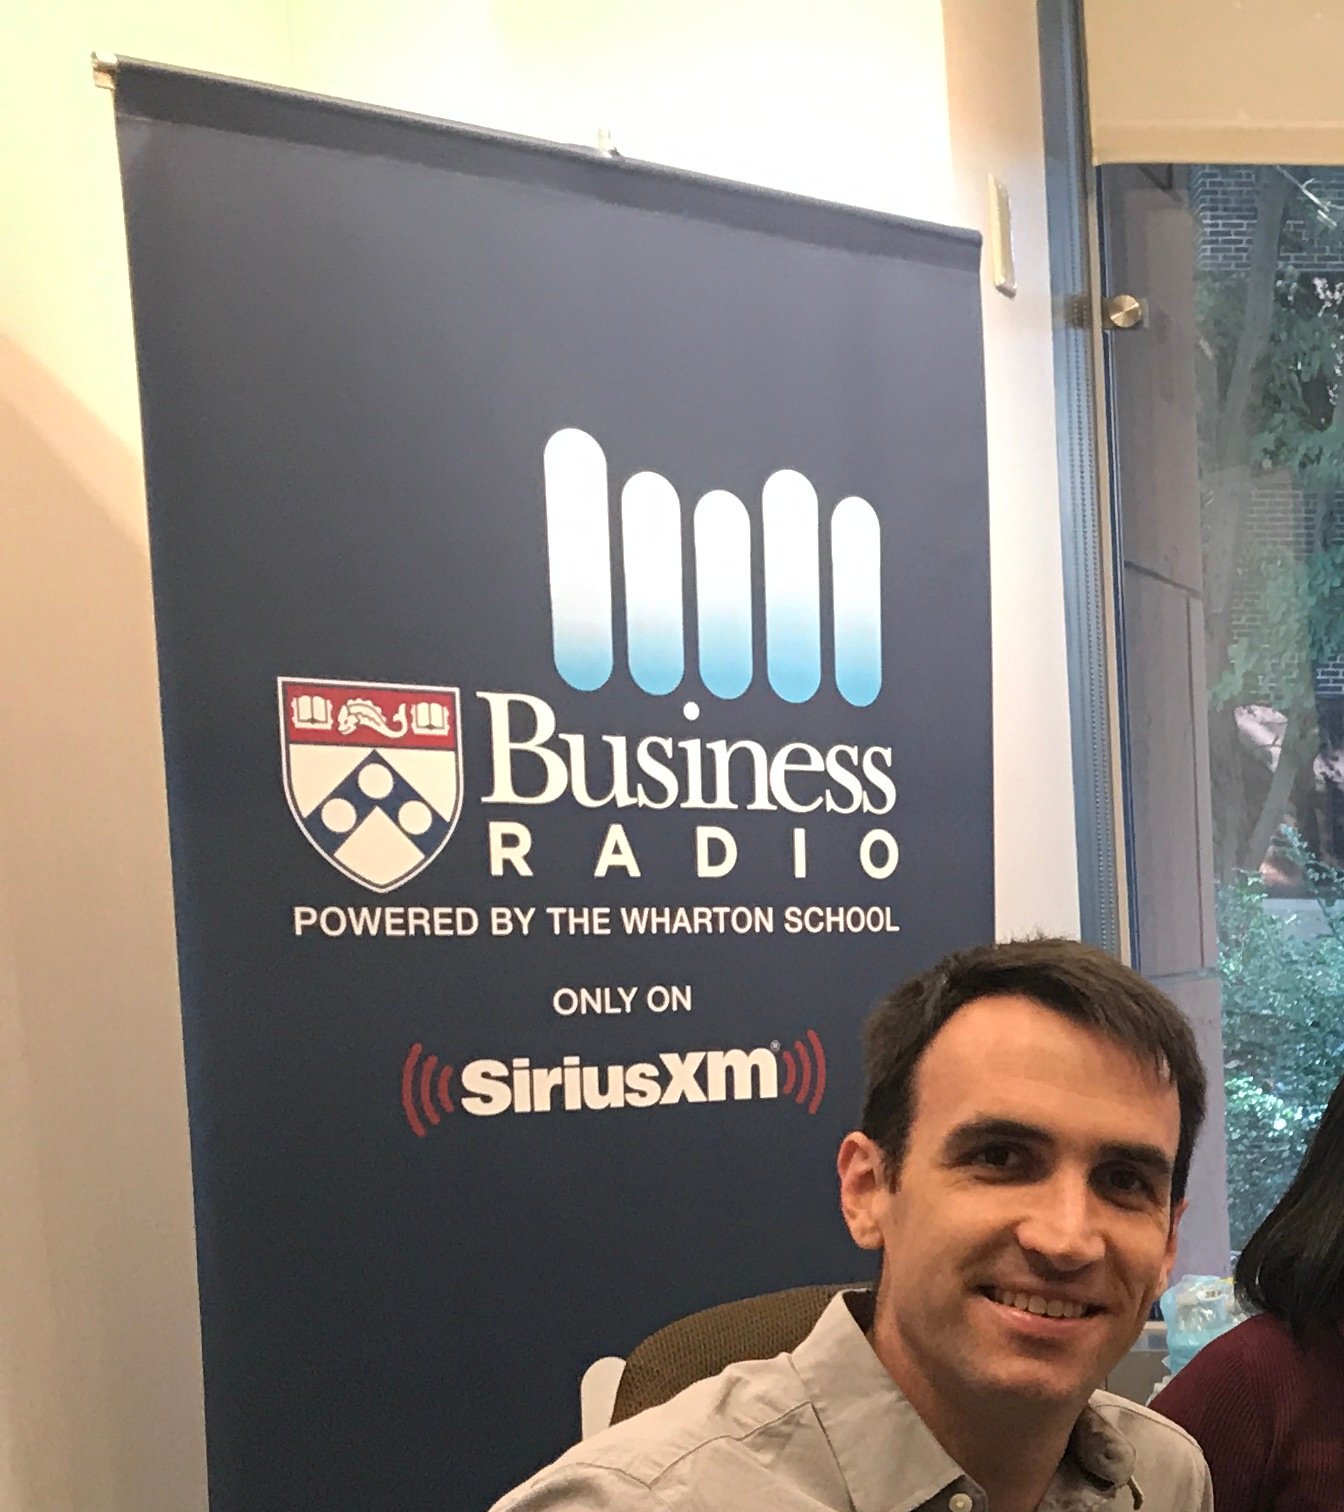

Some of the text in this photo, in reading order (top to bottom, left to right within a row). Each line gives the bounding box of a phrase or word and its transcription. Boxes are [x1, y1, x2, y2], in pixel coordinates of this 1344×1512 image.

[476, 690, 897, 815] Business
[488, 820, 900, 880] RADIO
[293, 905, 900, 938] POWERED BY THE WHARTON SCHOOL
[552, 985, 693, 1016] ONLY ON
